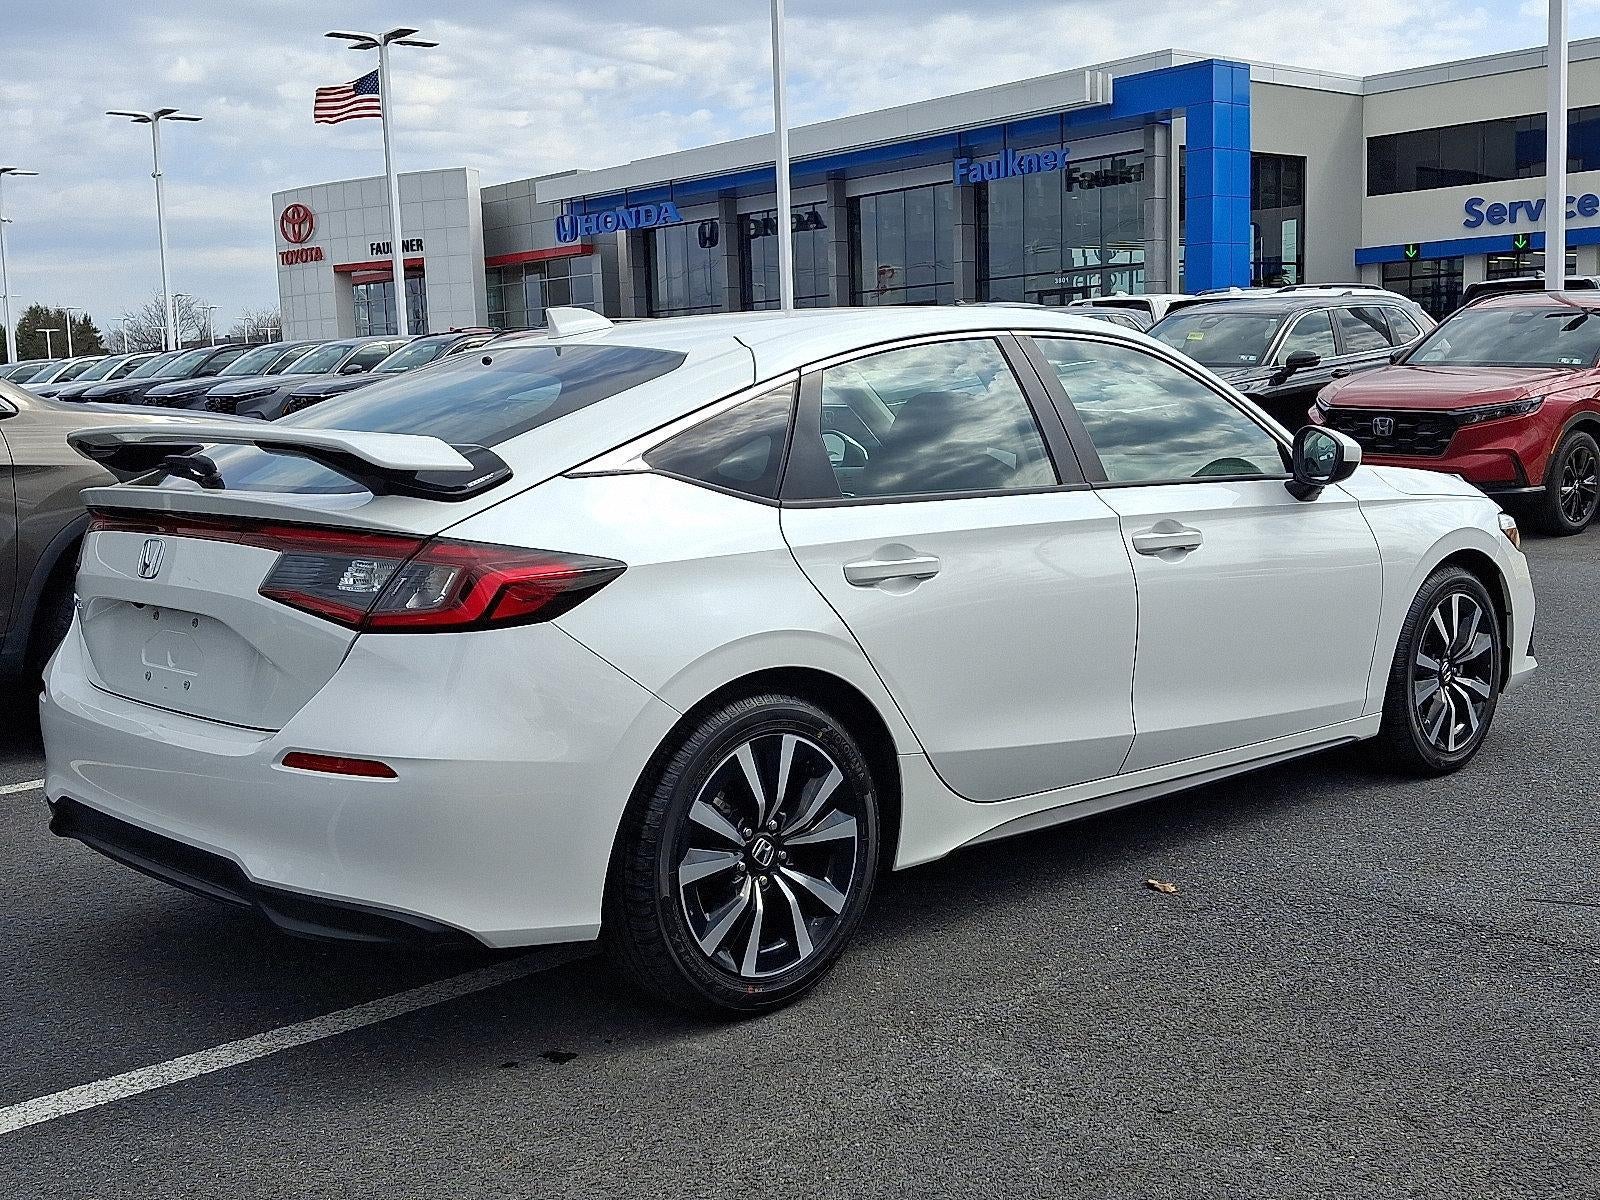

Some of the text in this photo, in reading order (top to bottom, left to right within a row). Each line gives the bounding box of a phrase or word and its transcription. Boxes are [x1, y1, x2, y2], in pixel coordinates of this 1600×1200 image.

[954, 148, 1070, 185] Faulkner
[578, 202, 683, 236] HONDA
[1463, 194, 1599, 228] Servce
[279, 246, 324, 266] TOYOTA
[370, 238, 423, 256] FAUNER
